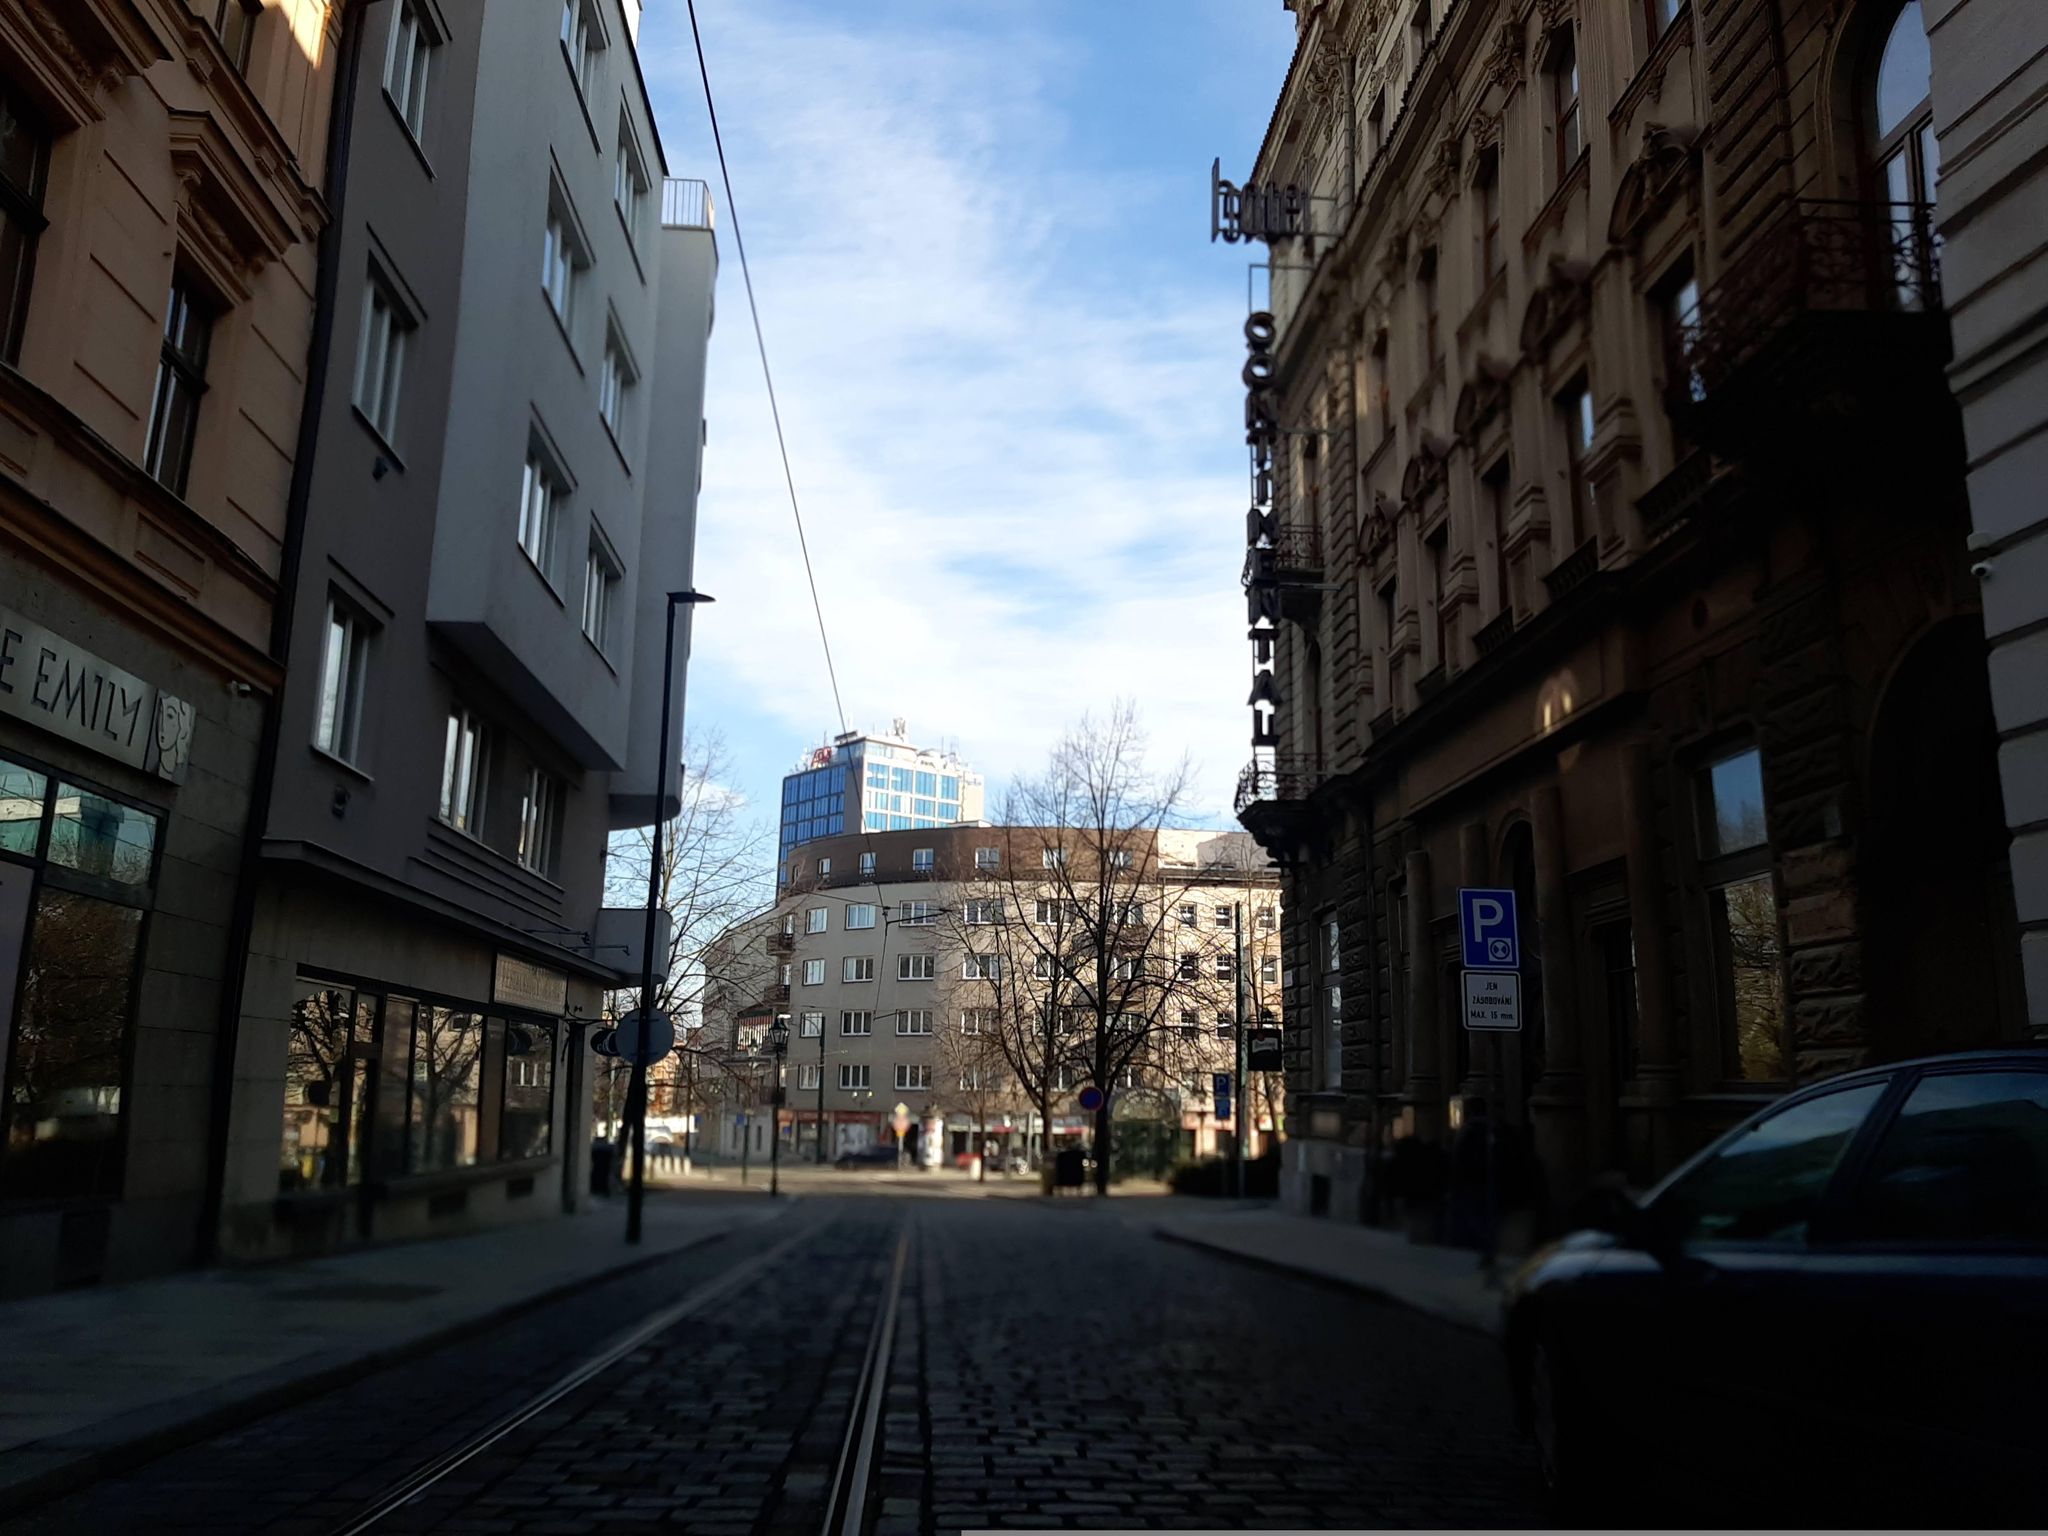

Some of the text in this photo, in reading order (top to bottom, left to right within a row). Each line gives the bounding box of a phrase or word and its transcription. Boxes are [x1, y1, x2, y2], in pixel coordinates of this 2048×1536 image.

[1243, 311, 1283, 746] CONTINENTAL
[31, 647, 143, 747] EMILY
[1472, 898, 1504, 943] P
[1485, 982, 1498, 991] JEN
[1491, 1011, 1498, 1020] 15
[1216, 1076, 1227, 1090] P
